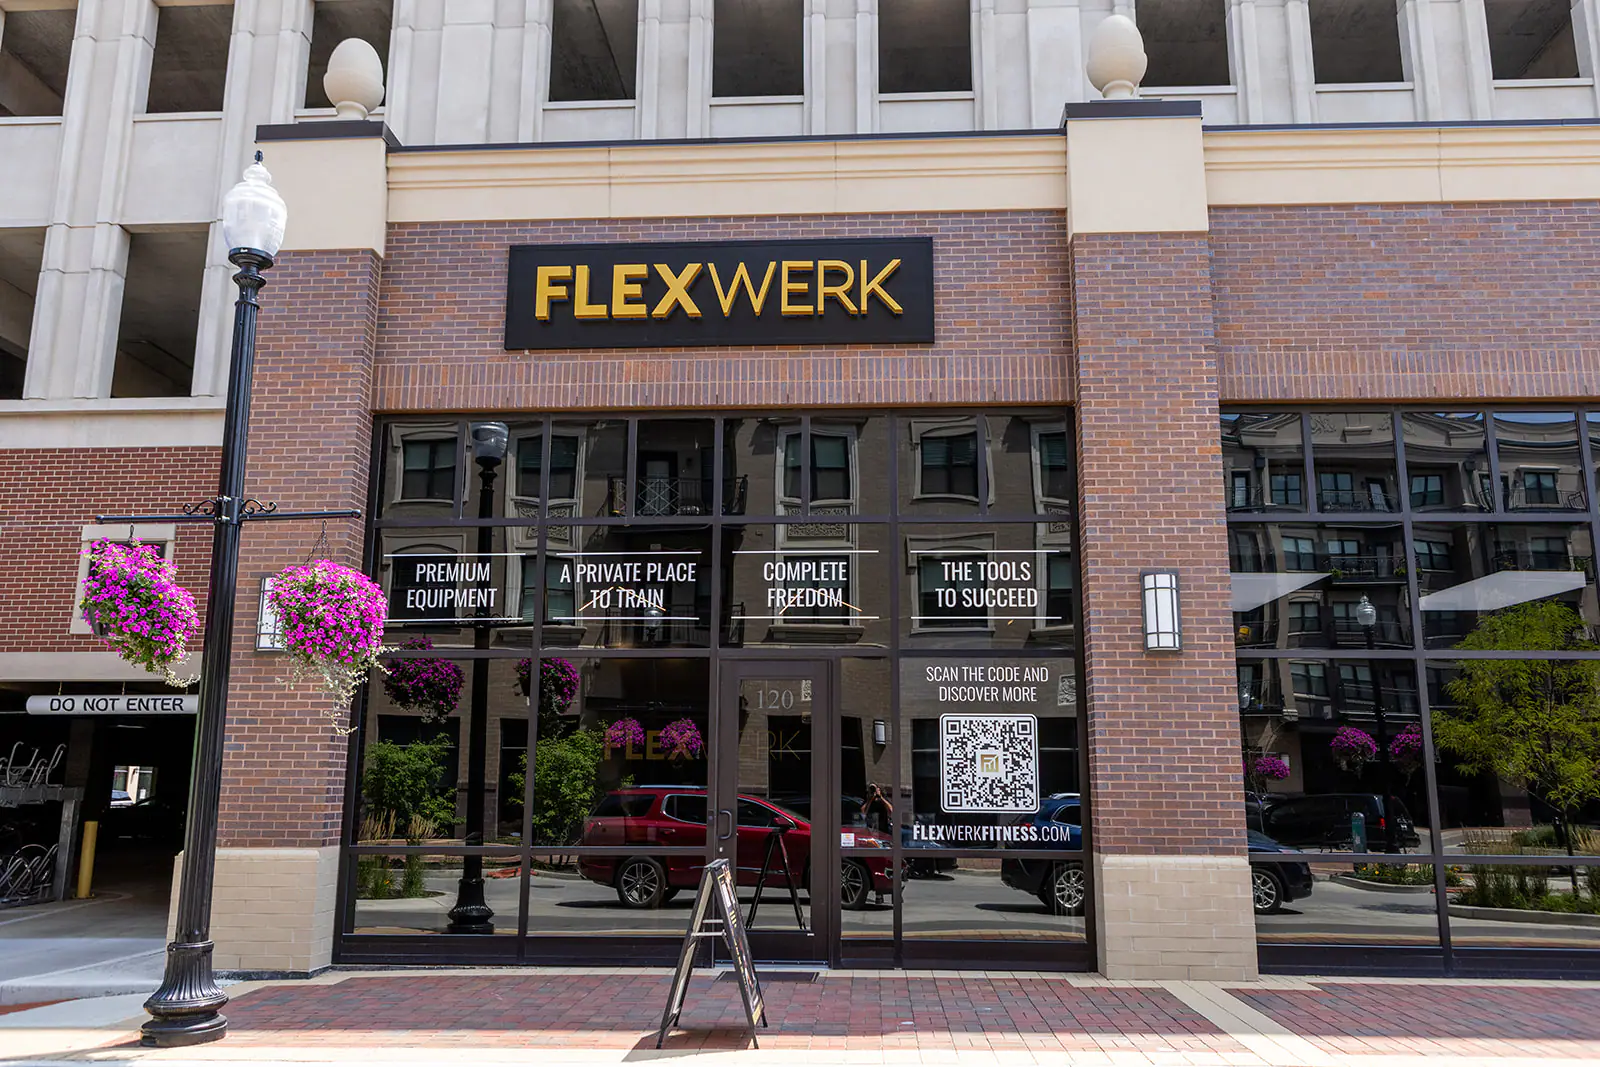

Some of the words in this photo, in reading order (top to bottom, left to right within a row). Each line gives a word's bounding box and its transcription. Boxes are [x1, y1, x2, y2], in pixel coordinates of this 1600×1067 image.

[535, 258, 904, 321] FLEXWERK
[415, 562, 491, 583] PREMIUM
[560, 564, 571, 583] A
[576, 563, 641, 583] PRIVATE
[646, 562, 697, 582] PLACE
[763, 561, 848, 581] COMPLETE
[941, 561, 973, 581] THE
[977, 561, 1031, 581] TOOLS
[406, 587, 498, 612] EQUIPMENT
[590, 588, 611, 609] TO
[616, 588, 664, 609] TRAIN
[767, 587, 843, 608] FREEDOM
[935, 587, 957, 608] TO
[962, 587, 1038, 608] SUCCEED
[926, 667, 959, 682] SCAN
[962, 667, 985, 682] THE
[988, 667, 1020, 682] CODE
[1023, 667, 1049, 682] AND
[757, 689, 794, 710] 120
[939, 686, 999, 702] DISCOVER
[1002, 686, 1038, 702] MORE
[50, 698, 75, 712] DO
[83, 698, 120, 712] NOT
[126, 698, 184, 712] ENTER
[913, 824, 1071, 842] FLEXWERKFITNESS.COM
